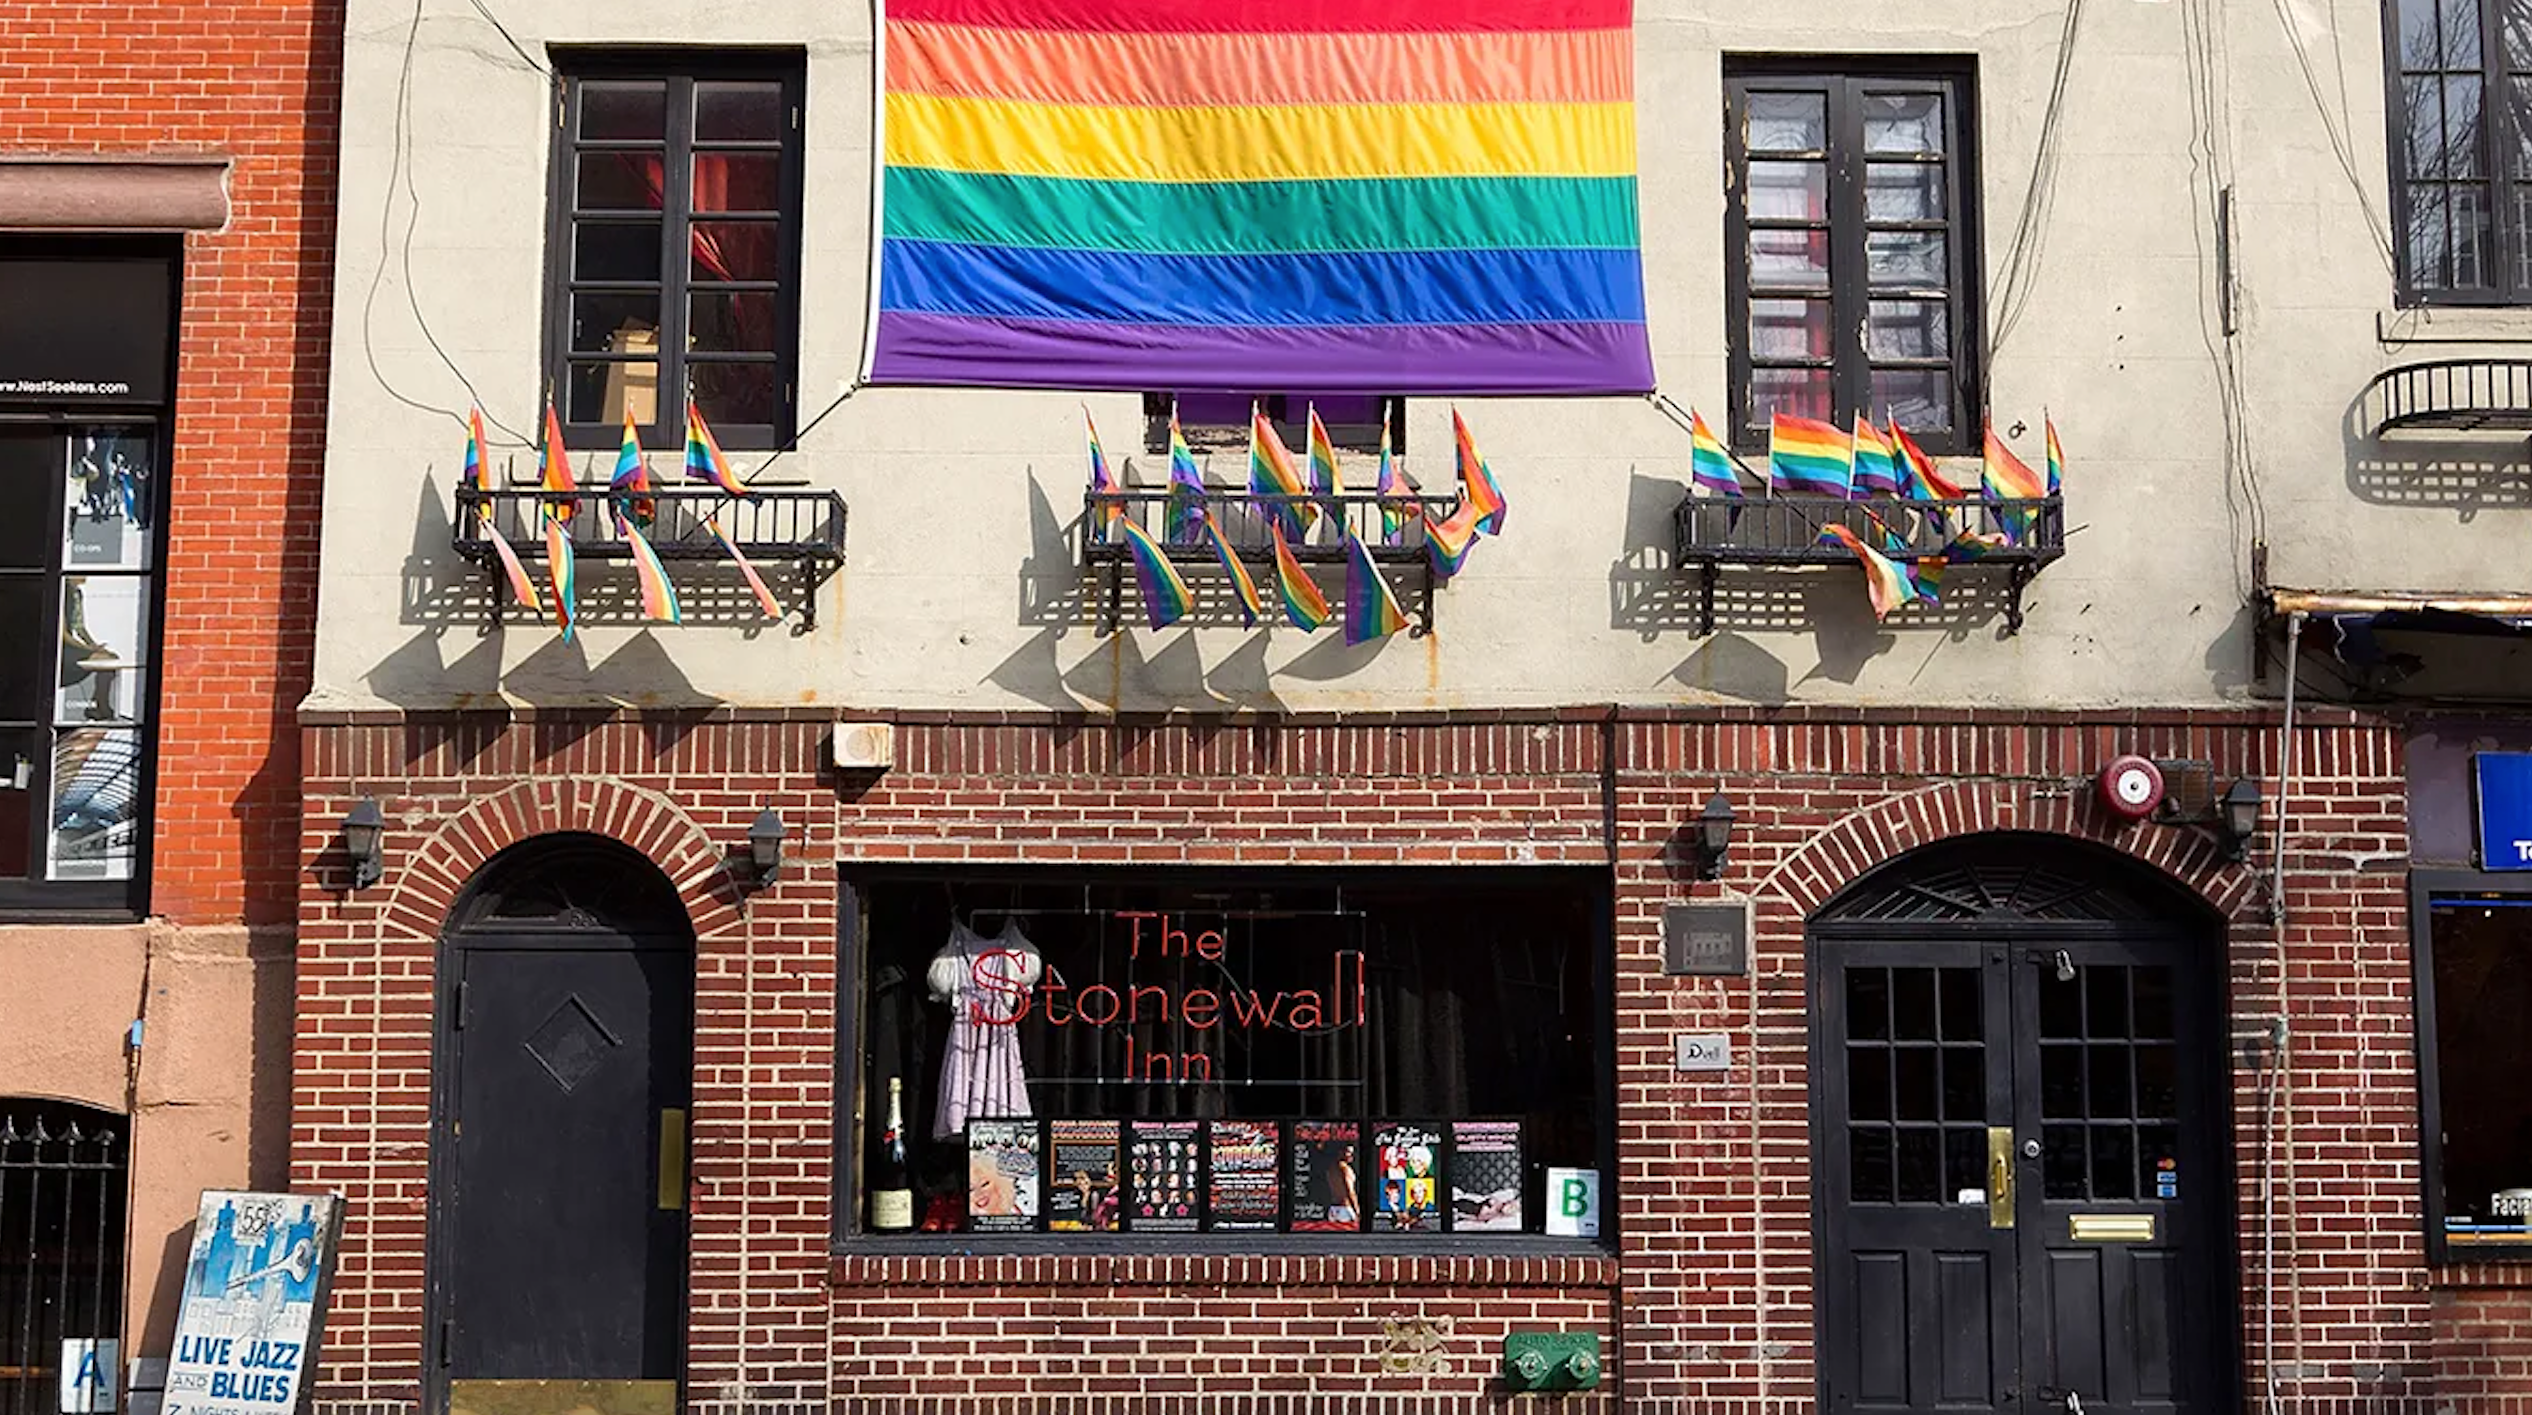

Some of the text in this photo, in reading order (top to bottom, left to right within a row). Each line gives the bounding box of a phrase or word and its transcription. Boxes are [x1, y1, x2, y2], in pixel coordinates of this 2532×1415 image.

[1115, 911, 1224, 960] The
[972, 947, 1365, 1028] Stonewall
[1127, 1034, 1210, 1082] Inn
[1562, 1178, 1588, 1218] B
[73, 1351, 105, 1388] A
[179, 1335, 302, 1371] LIVE JAZZ
[173, 1371, 291, 1403] AND BLUES
